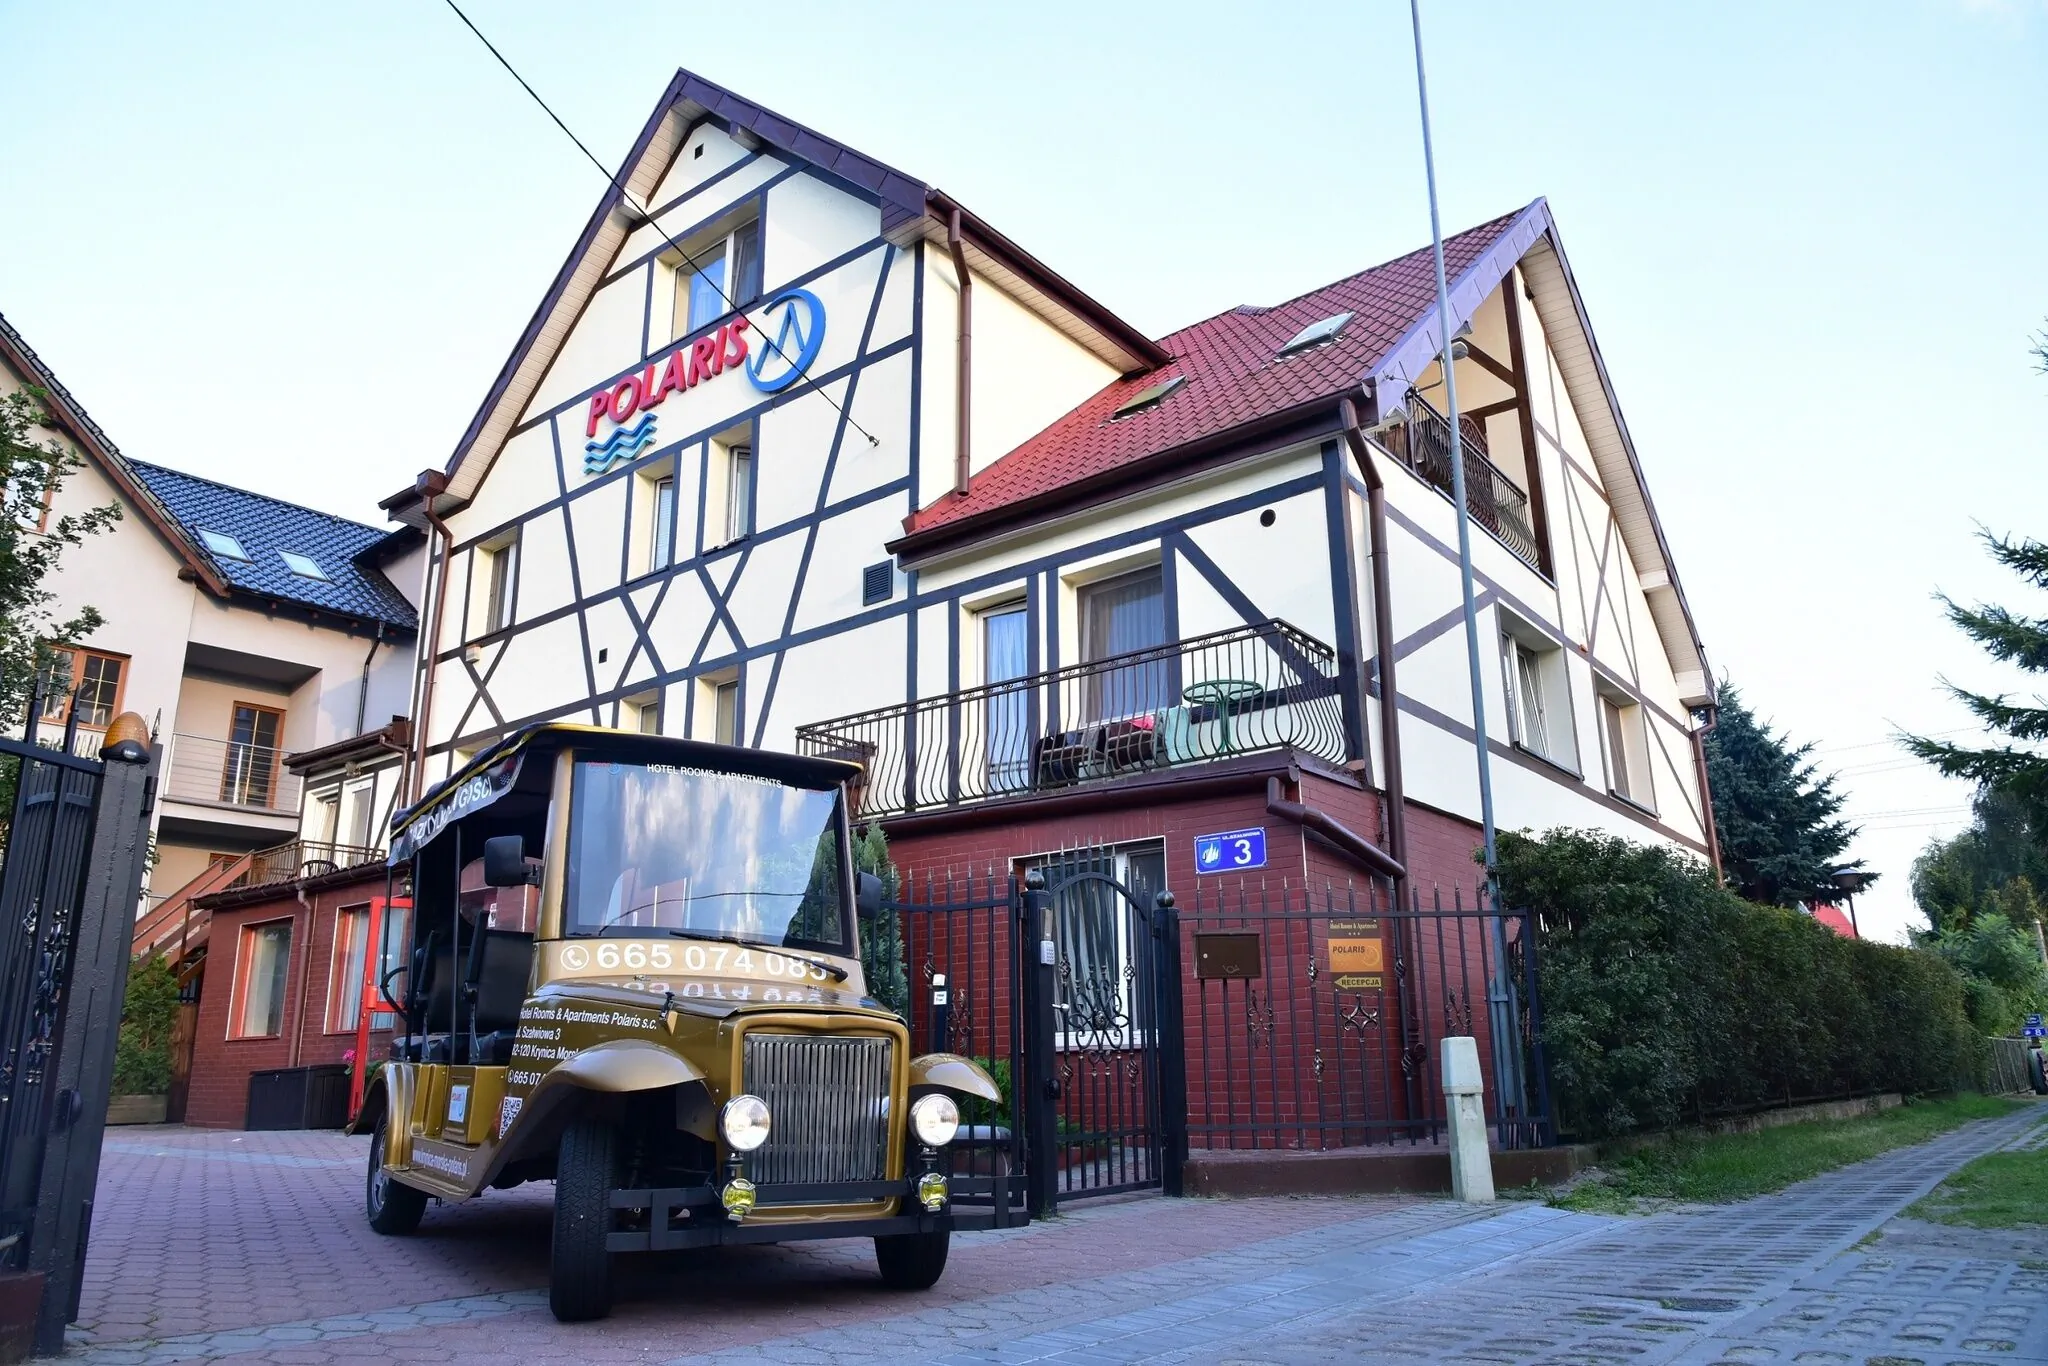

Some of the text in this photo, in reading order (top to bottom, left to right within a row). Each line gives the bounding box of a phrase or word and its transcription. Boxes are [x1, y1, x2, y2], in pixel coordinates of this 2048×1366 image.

[585, 315, 750, 438] POLARIS
[646, 763, 783, 789] HOTEL ROOMS & APARTMENTS
[1234, 839, 1252, 865] 3
[1332, 945, 1366, 954] POLARIS
[596, 943, 828, 981] 665 074 085
[533, 1007, 556, 1020] Rooms
[556, 1007, 563, 1020] &
[562, 1008, 610, 1024] Apartments
[610, 1012, 641, 1028] Polaris
[641, 1018, 657, 1030] s.c.
[554, 1028, 562, 1040] 3
[530, 1044, 556, 1060] Krynica
[513, 1070, 529, 1085] 665
